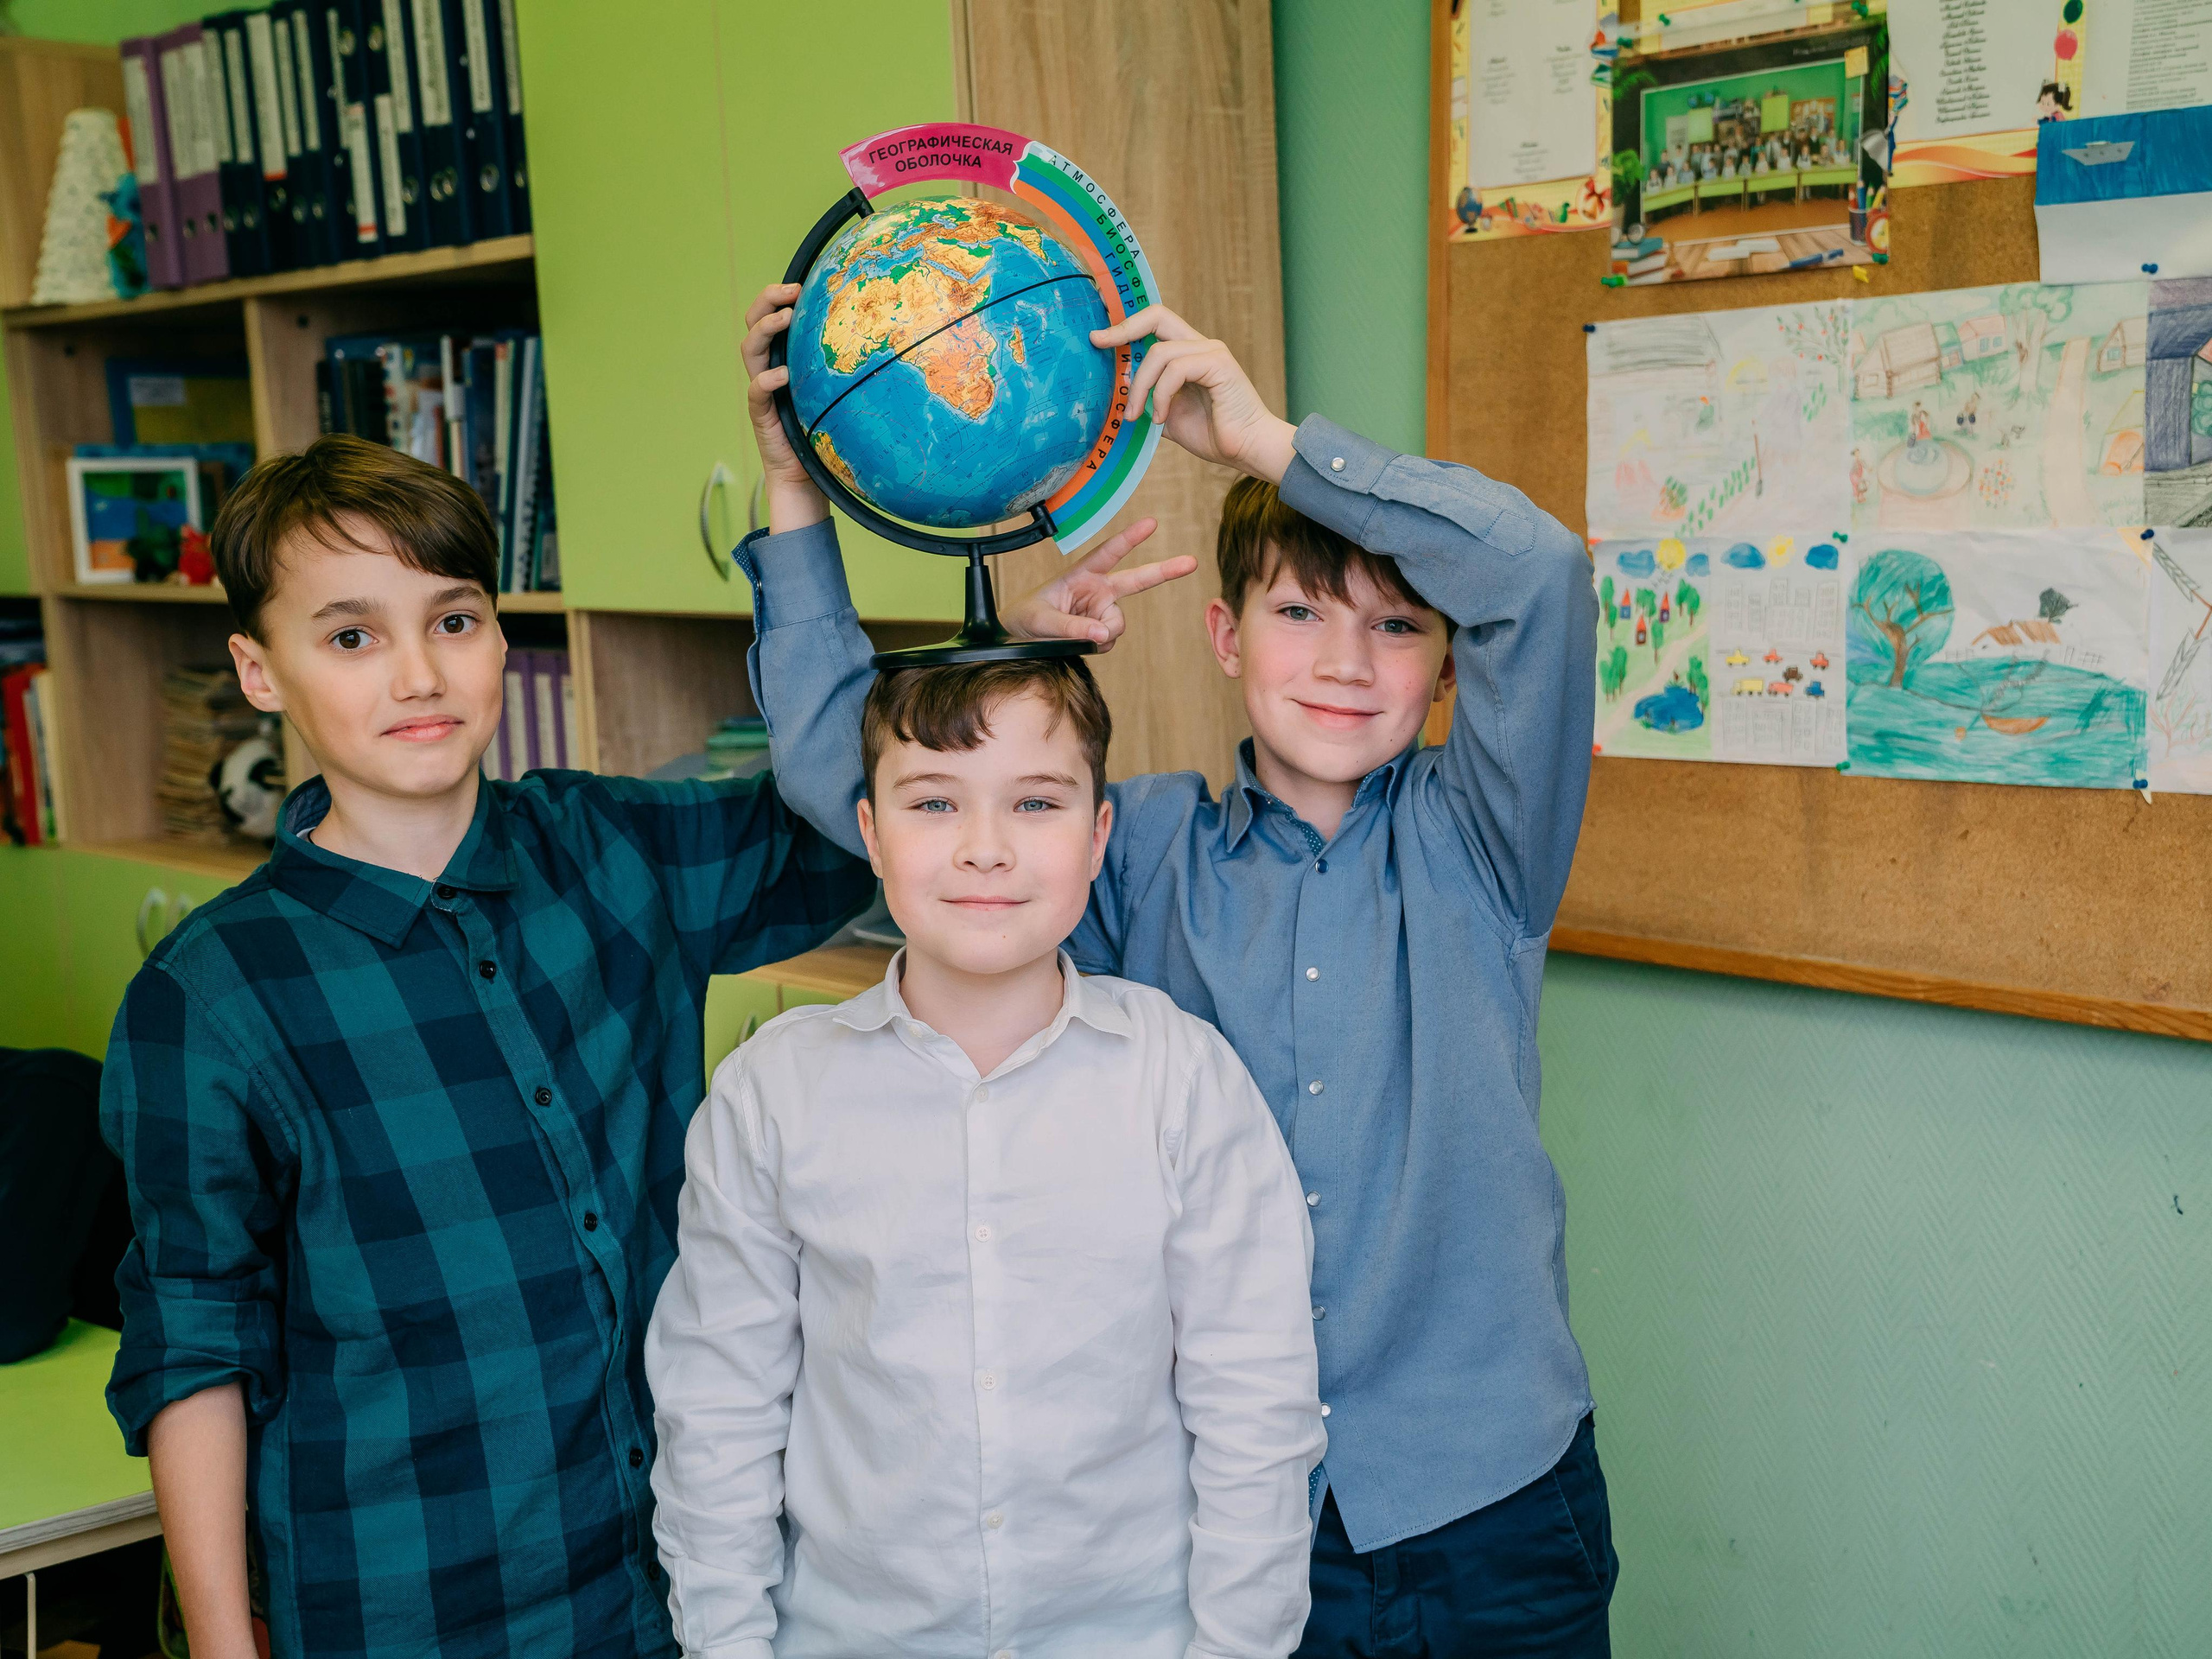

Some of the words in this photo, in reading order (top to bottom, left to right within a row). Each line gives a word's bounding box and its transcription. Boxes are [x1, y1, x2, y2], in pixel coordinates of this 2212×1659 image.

[868, 136, 1013, 163] ГЕОГРАФИЧЕСКАЯ
[895, 154, 982, 172] ОБОЛОЧКА
[1048, 155, 1140, 259] АТМОСФЕРА
[1096, 213, 1147, 304] БИОСФЕ
[1086, 343, 1131, 470] ИТОСФЕРА
